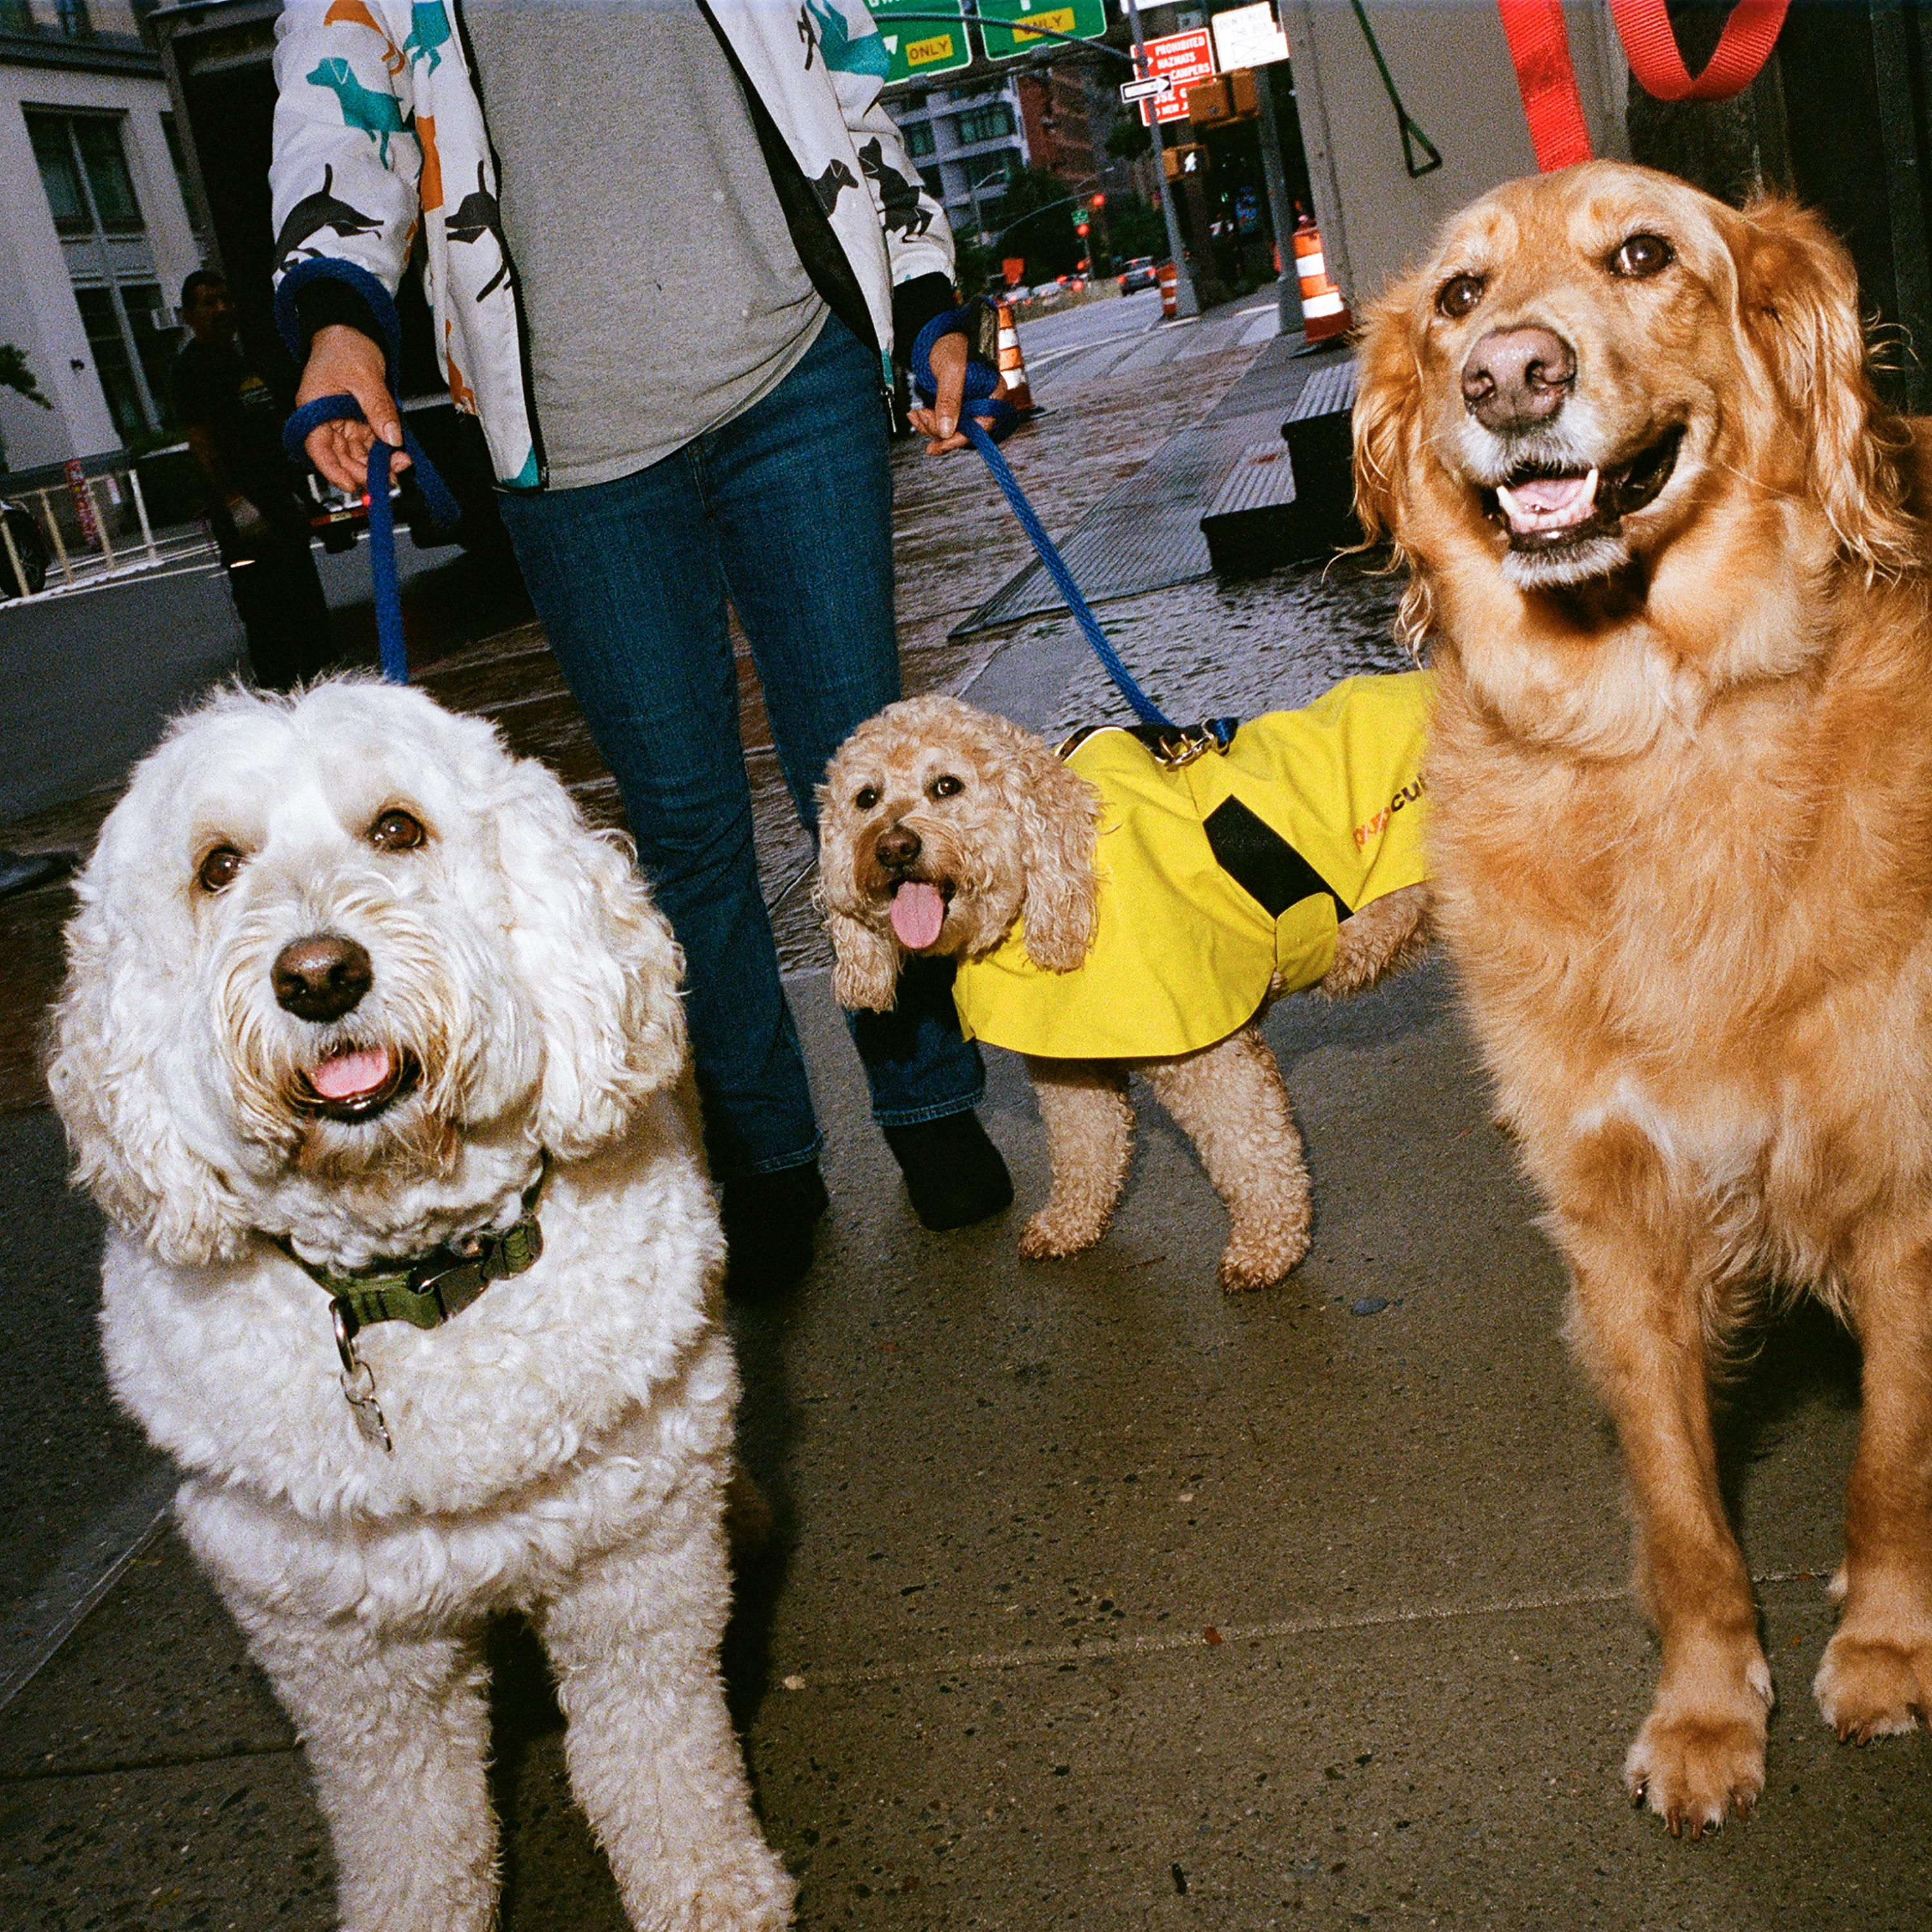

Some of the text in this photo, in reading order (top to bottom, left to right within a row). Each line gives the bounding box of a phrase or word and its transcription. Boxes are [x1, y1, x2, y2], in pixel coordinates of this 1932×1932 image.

[909, 40, 948, 61] ONLY
[1155, 35, 1206, 56] PROHIBITED
[1157, 52, 1197, 70] HAZMATS
[1170, 62, 1211, 80] CAMPERS
[1161, 104, 1179, 115] NEW
